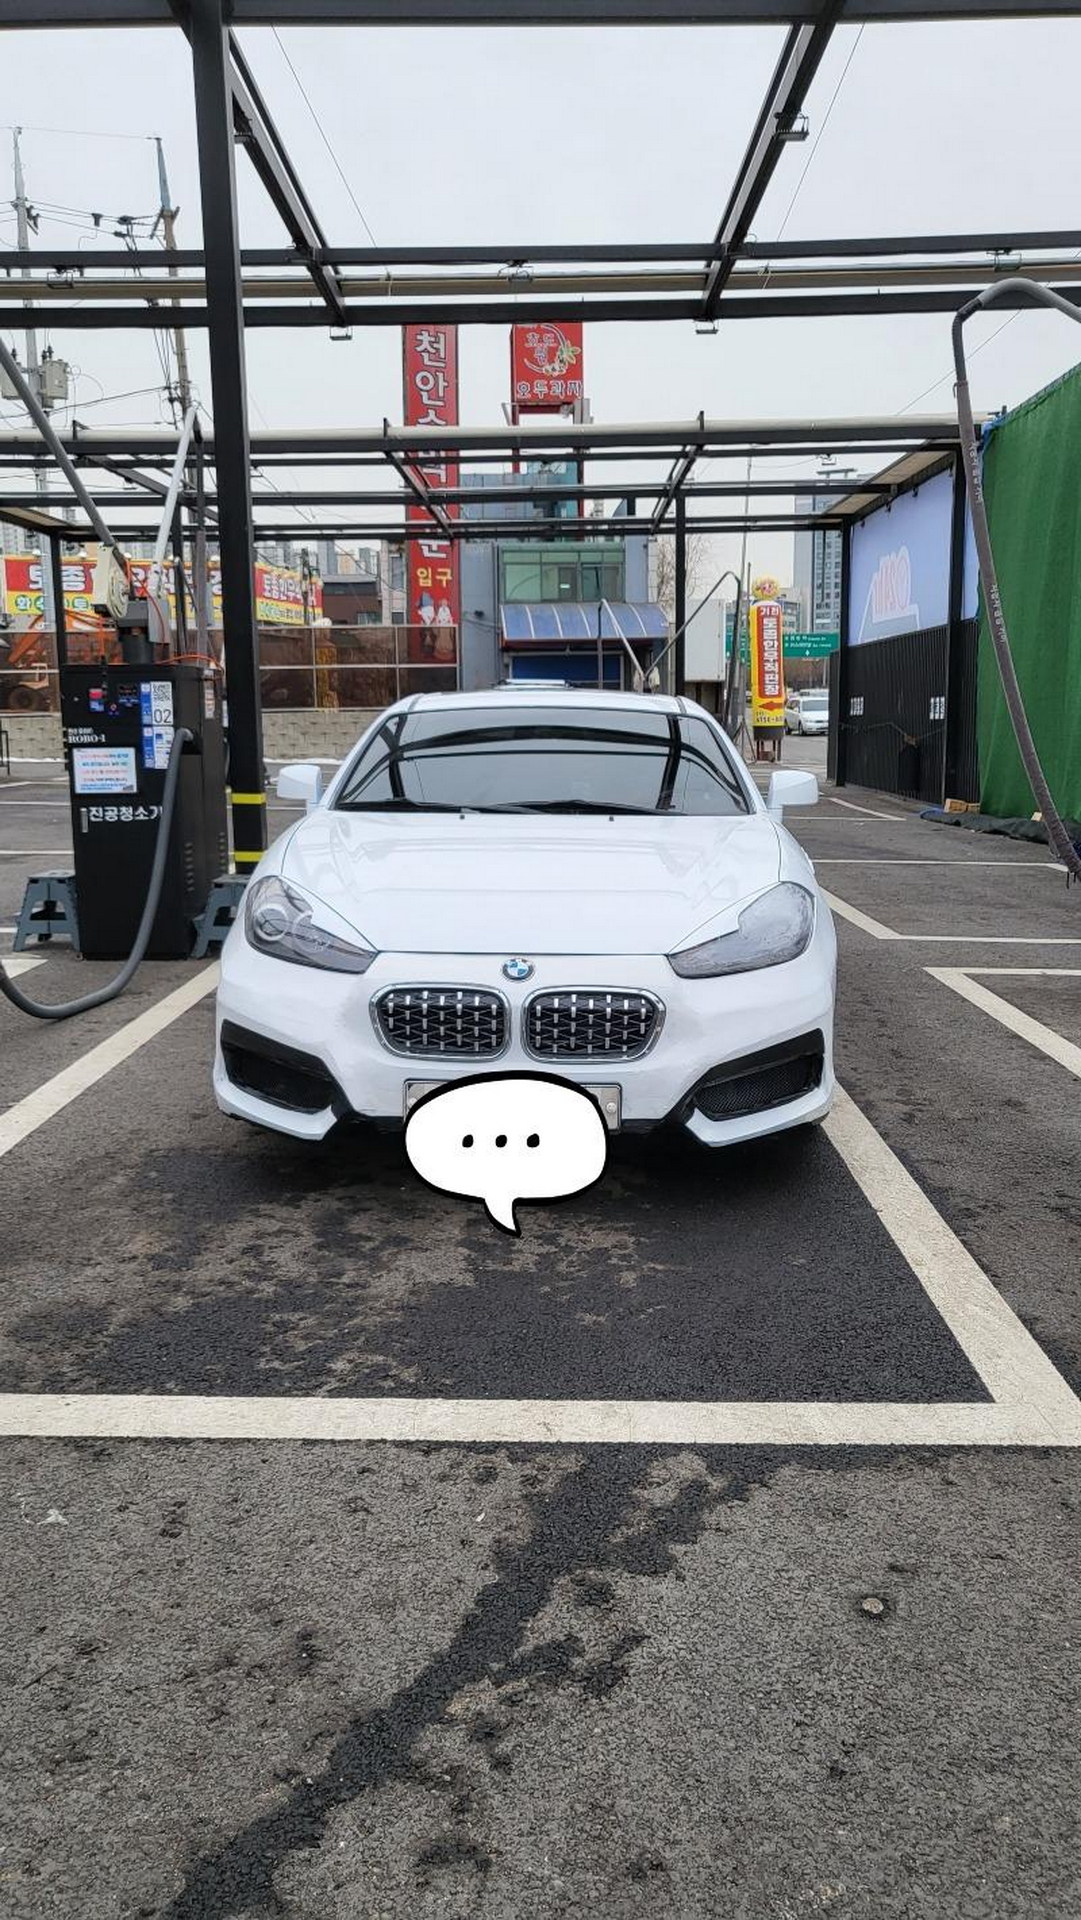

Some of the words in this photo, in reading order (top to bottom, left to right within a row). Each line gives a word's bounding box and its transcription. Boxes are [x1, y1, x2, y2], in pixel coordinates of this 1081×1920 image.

[415, 566, 453, 588] 입구
[153, 708, 172, 724] 02
[88, 805, 163, 822] 진공청소기
